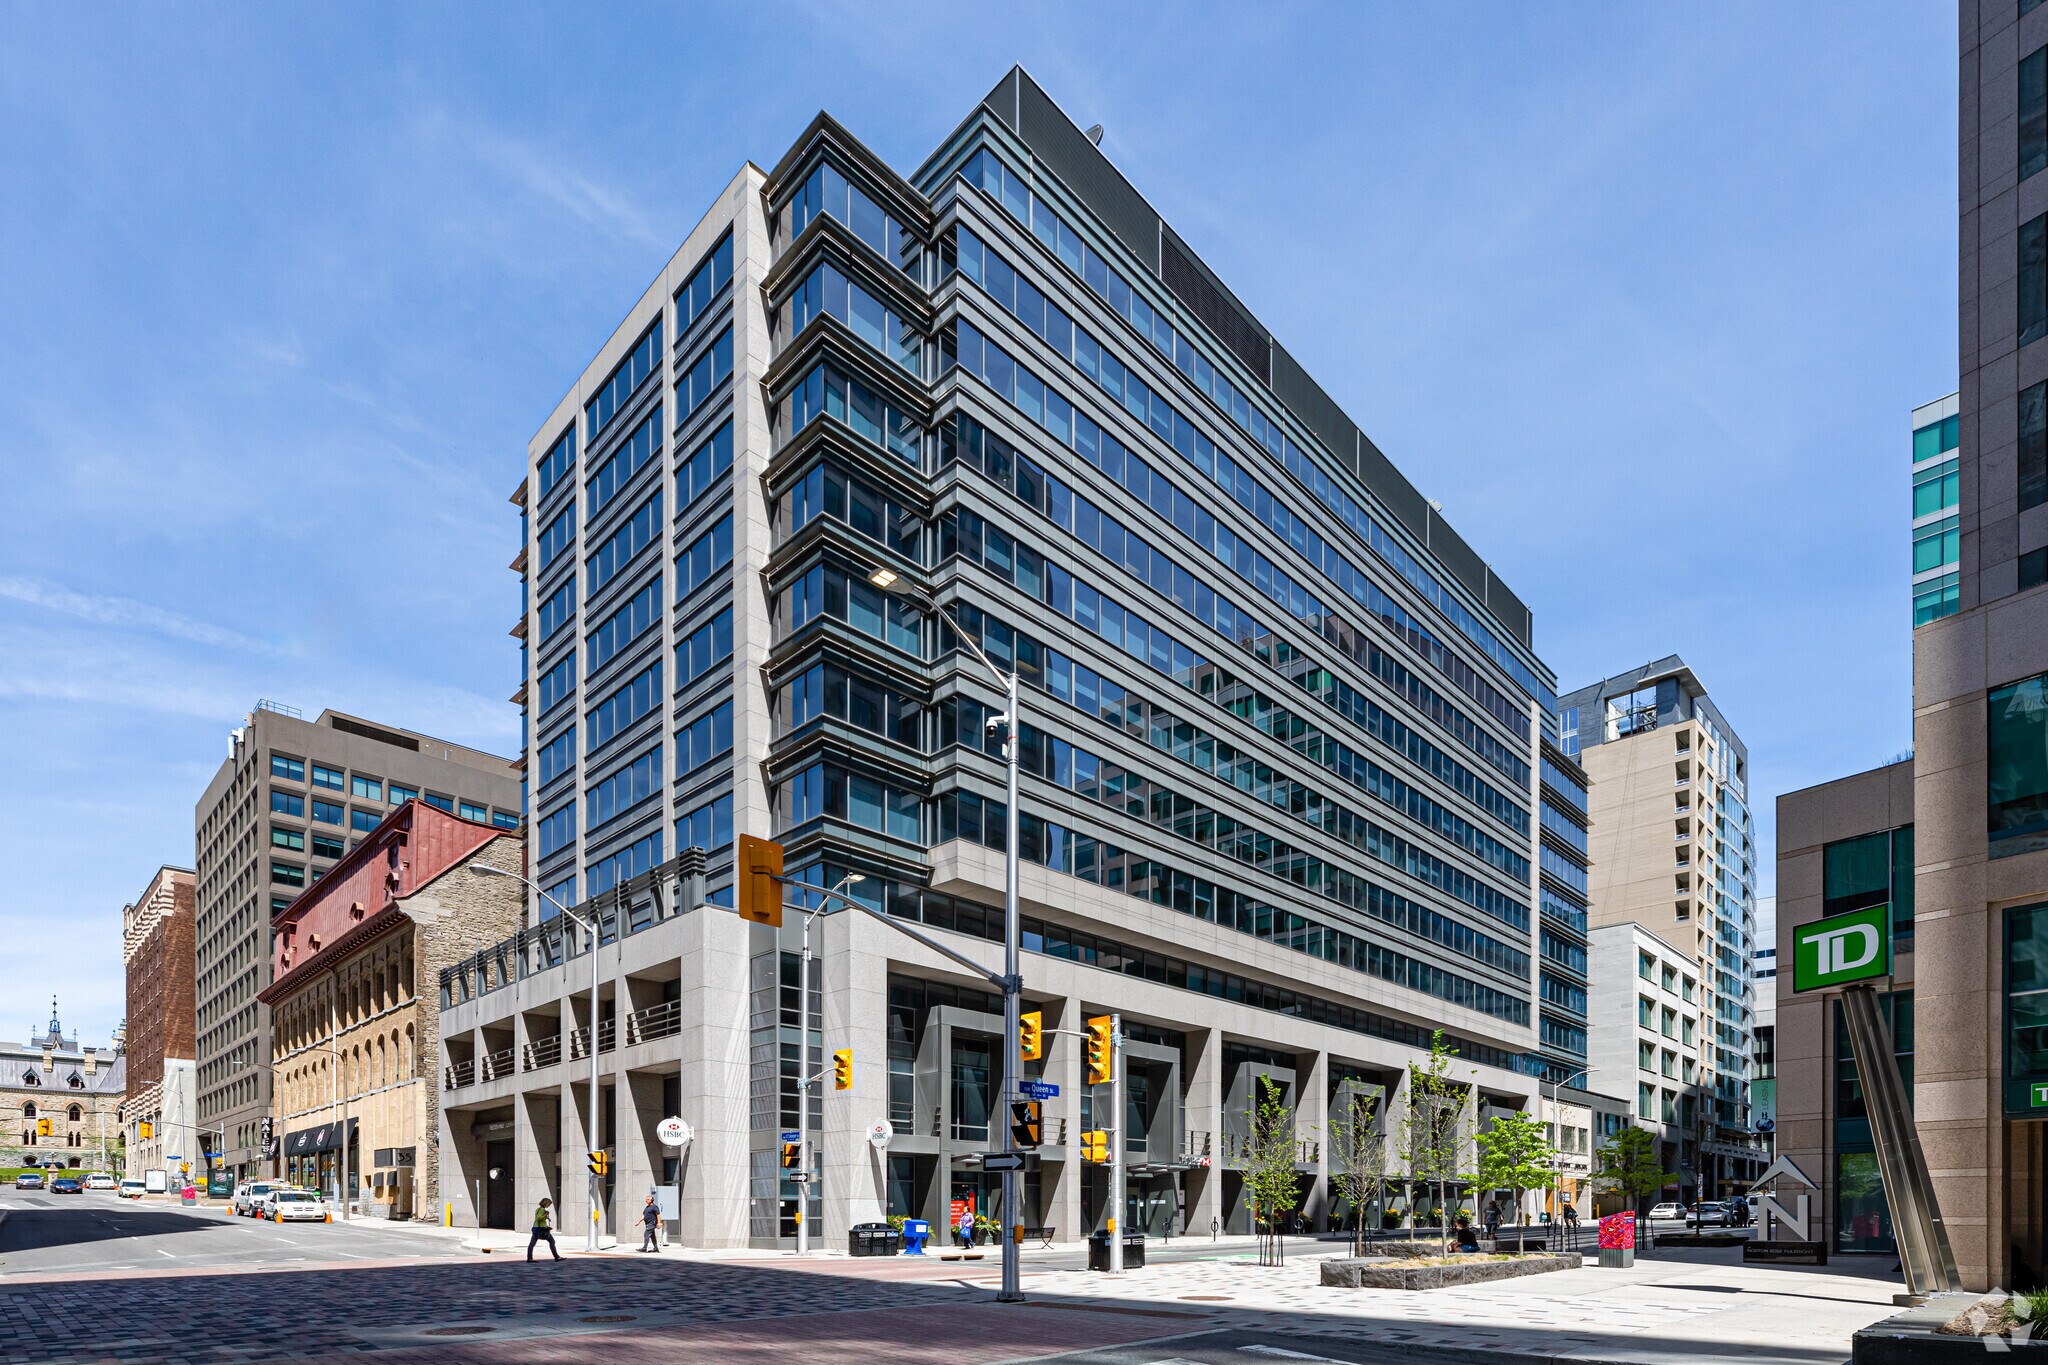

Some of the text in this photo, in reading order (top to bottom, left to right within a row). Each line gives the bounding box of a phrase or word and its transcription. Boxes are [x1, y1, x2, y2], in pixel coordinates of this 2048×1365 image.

[1802, 923, 1880, 975] TD
[1031, 1084, 1049, 1093] Queen
[1761, 1080, 1769, 1110] LEASING
[2034, 1087, 2048, 1102] T
[663, 1130, 685, 1138] HSBC
[872, 1132, 886, 1140] HSBC
[398, 1152, 412, 1163] 35
